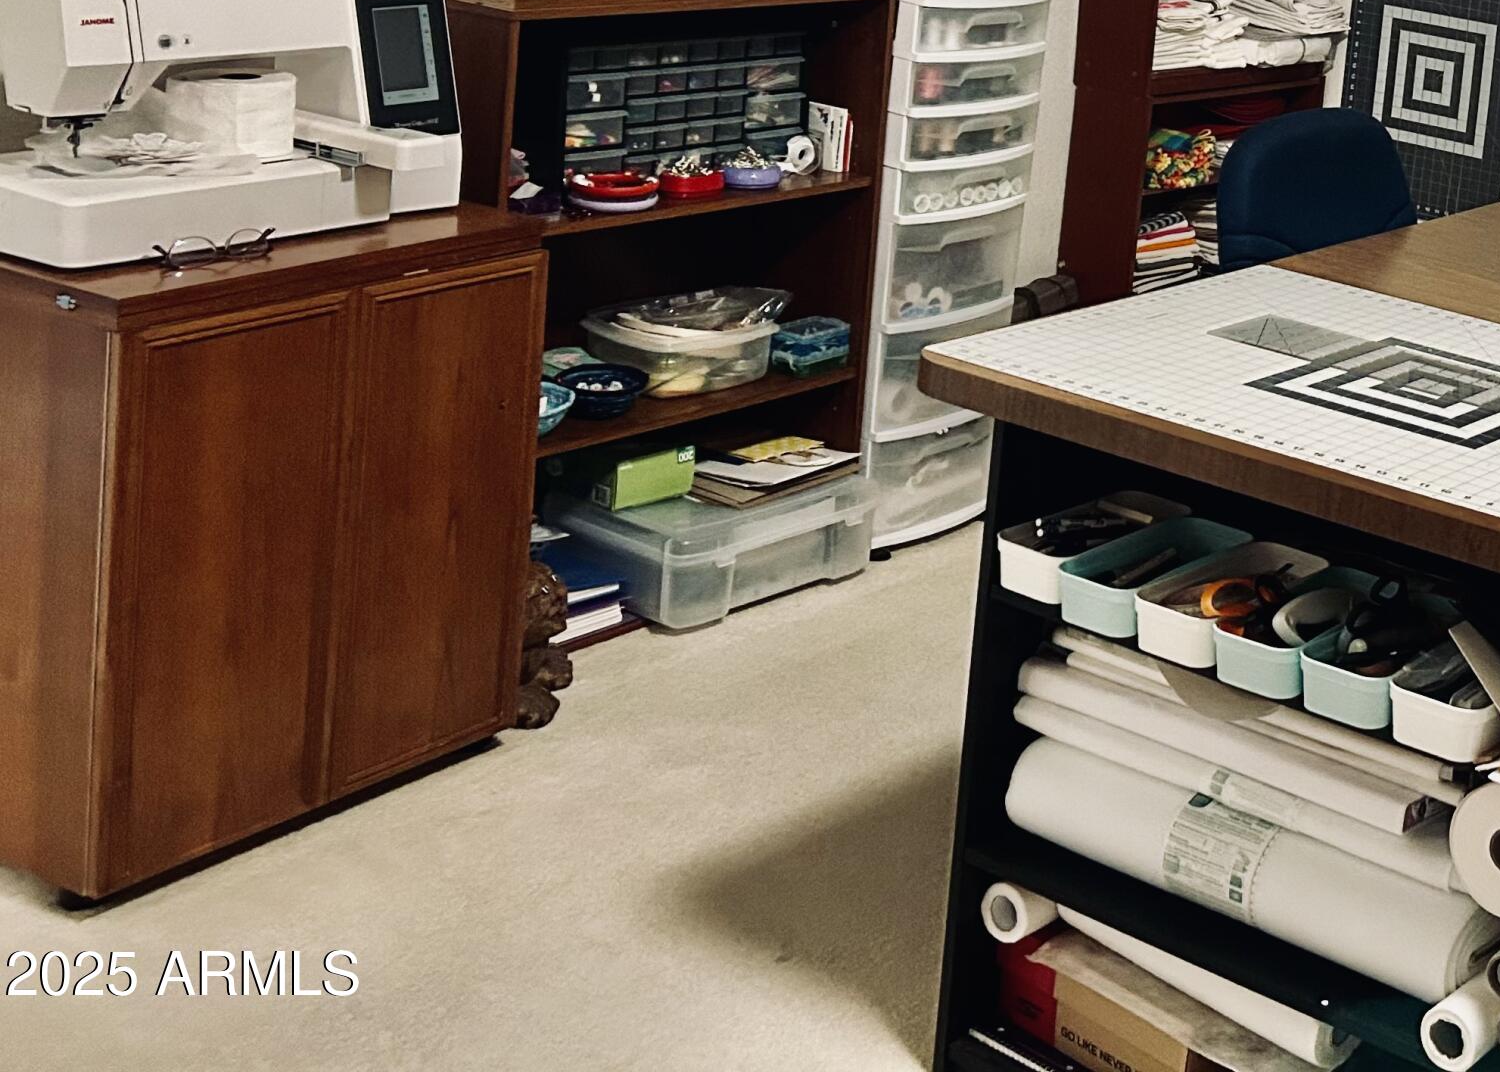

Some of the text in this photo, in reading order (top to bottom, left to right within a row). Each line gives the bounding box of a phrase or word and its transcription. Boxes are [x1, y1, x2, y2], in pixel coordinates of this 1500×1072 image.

[80, 17, 115, 26] JANOME
[1060, 1026, 1075, 1042] GO
[1077, 1034, 1097, 1057] LIKE
